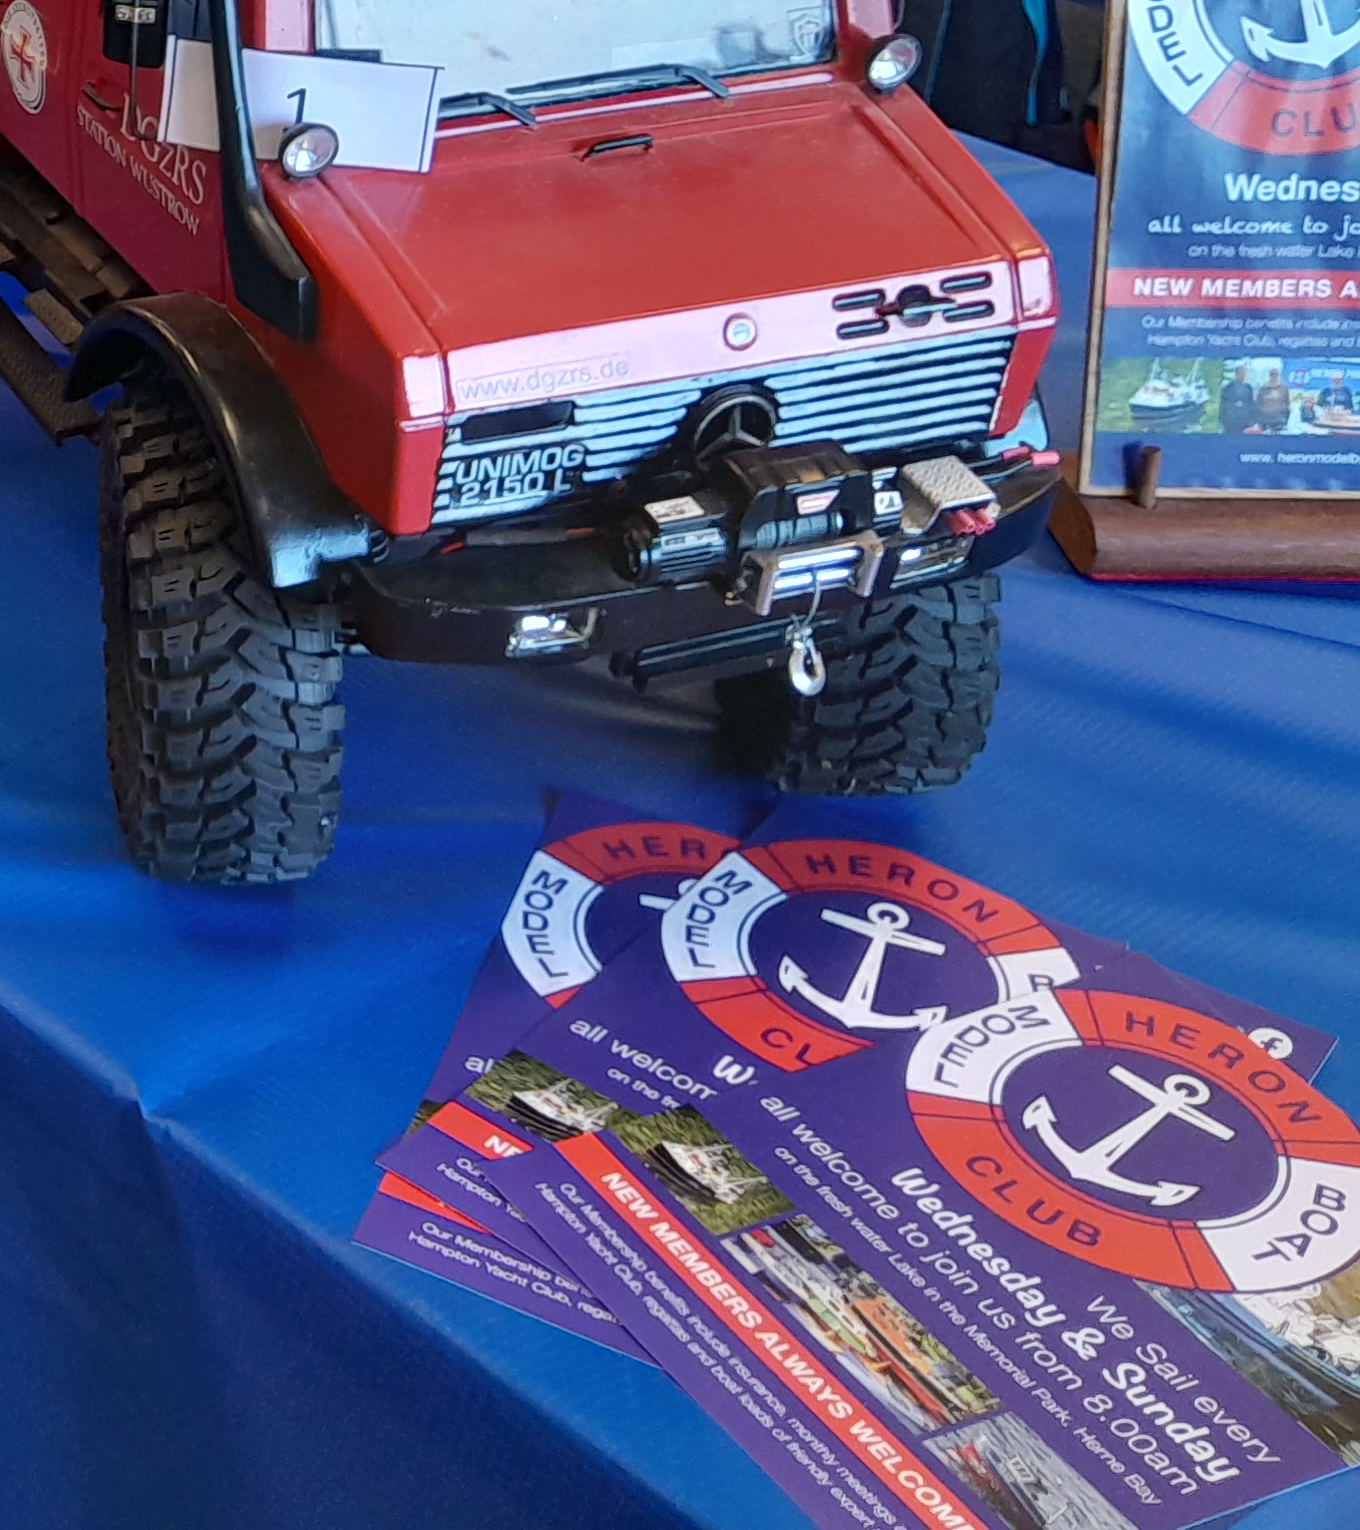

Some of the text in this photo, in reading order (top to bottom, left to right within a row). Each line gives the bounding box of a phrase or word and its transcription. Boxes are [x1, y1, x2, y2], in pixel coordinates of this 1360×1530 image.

[76, 104, 128, 168] STATION
[286, 87, 307, 125] 1
[1148, 215, 1183, 234] all
[1192, 216, 1293, 235] welcome
[1302, 214, 1329, 234] to
[1133, 277, 1360, 299] NEW MEMBERS A
[458, 358, 630, 401] www.dgzrs.de
[455, 443, 585, 485] UNIMOG
[459, 468, 572, 508] 2150 L
[602, 836, 726, 861] HER
[522, 870, 569, 978] MODEL
[685, 868, 753, 970] MODEL
[805, 853, 1000, 924] HERON
[569, 1019, 610, 1044] all
[934, 1004, 1052, 1088] MODEL
[606, 1067, 631, 1085] on
[631, 1080, 661, 1101] the
[1125, 1011, 1321, 1126] HERON
[436, 1162, 503, 1207] Hampton
[966, 1155, 1103, 1247] CLUB
[421, 1221, 453, 1240] Our
[454, 1233, 552, 1283] Membership
[1253, 1183, 1347, 1263] BOAT
[408, 1230, 481, 1269] Hampton
[484, 1261, 529, 1288] Yacht
[534, 1181, 587, 1234] Hampton
[687, 1341, 718, 1367] and
[771, 1427, 793, 1444] of
[760, 1096, 1199, 1495] all welcome to join us from 8.00am
[774, 1146, 797, 1166] on
[793, 1161, 820, 1188] the
[815, 1185, 854, 1220] fresh
[850, 1217, 892, 1254] water
[888, 1253, 927, 1289] Lake
[923, 1286, 941, 1304] in
[939, 1300, 966, 1326] the
[963, 1324, 1037, 1390] Memorial
[1073, 1426, 1126, 1474] Herne
[1124, 1473, 1163, 1506] Bay
[891, 1167, 1241, 1484] Wednesday & Sunday
[559, 1182, 585, 1206] Our
[580, 1204, 648, 1273] Membership
[835, 1466, 897, 1526] meetings
[601, 1171, 978, 1530] NEW MEMBERS ALWAYS WELCOM
[1087, 1295, 1282, 1464] We Sail every
